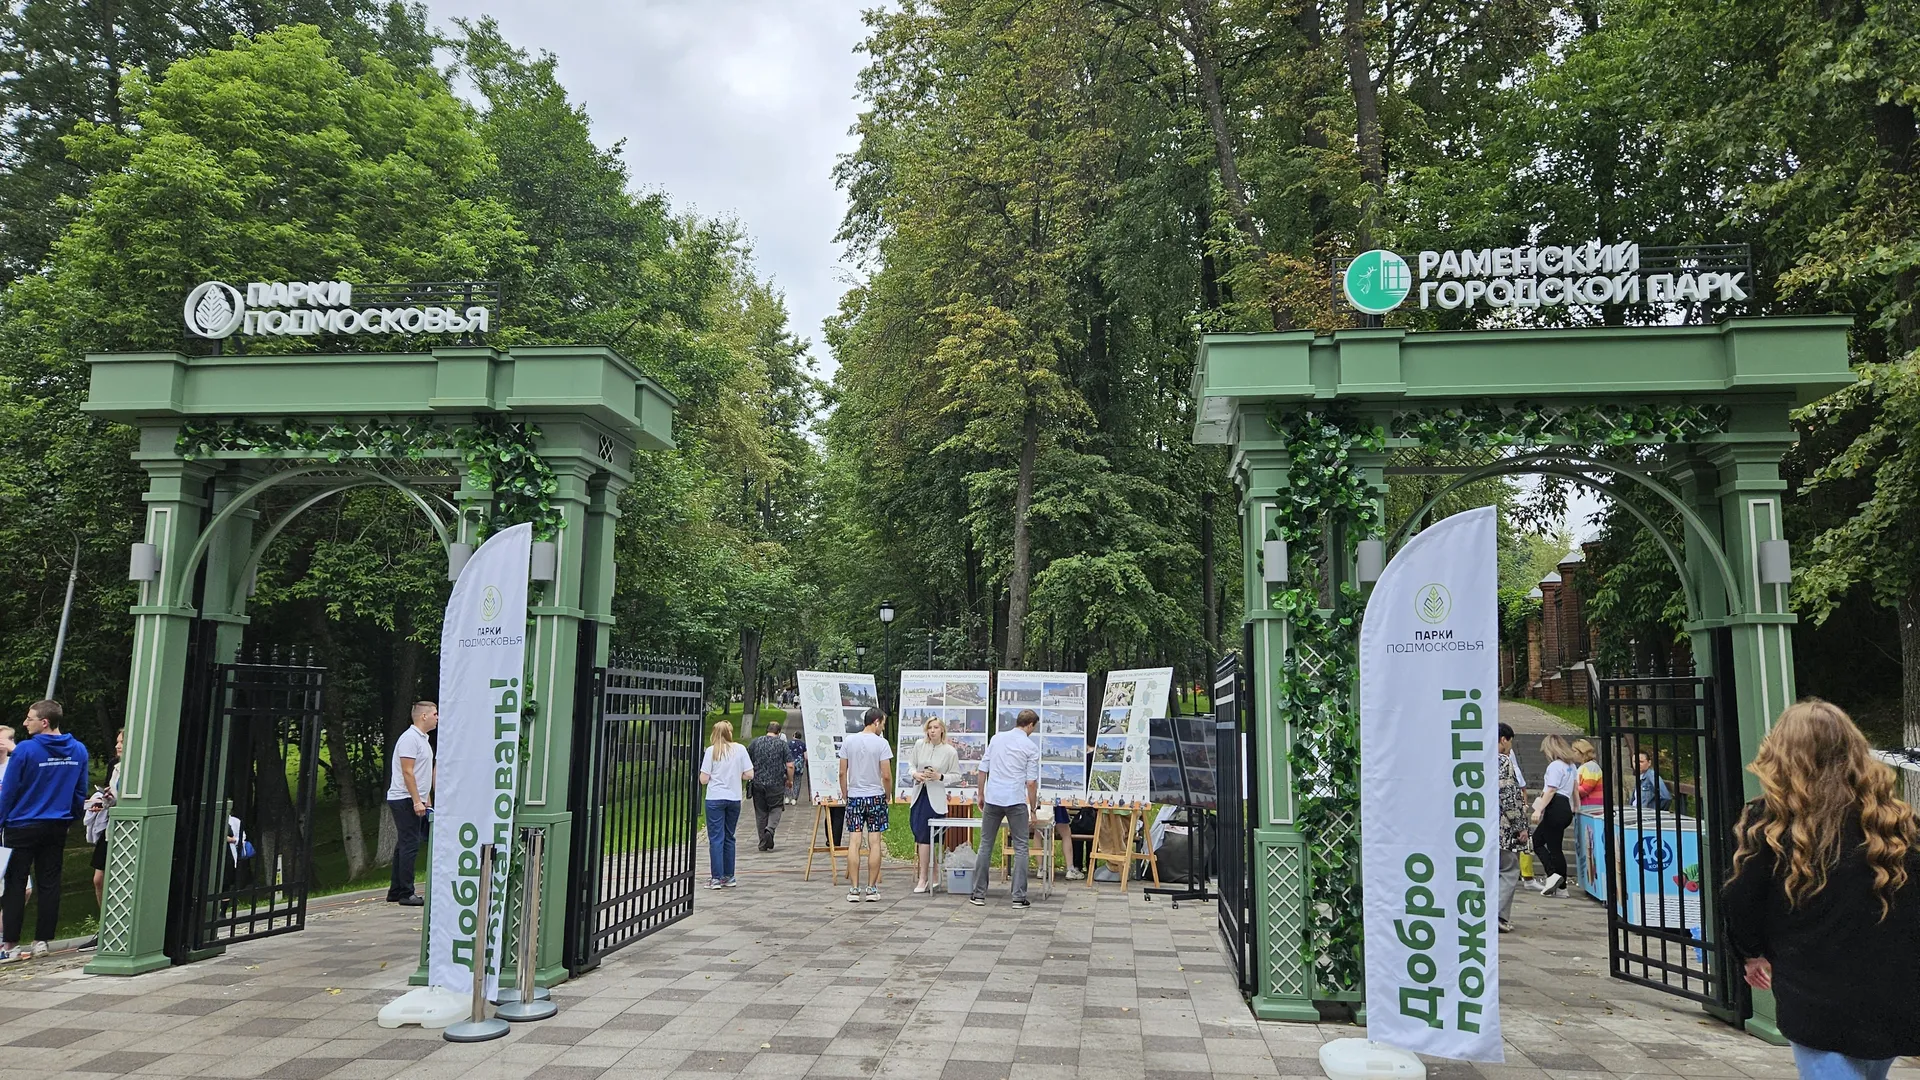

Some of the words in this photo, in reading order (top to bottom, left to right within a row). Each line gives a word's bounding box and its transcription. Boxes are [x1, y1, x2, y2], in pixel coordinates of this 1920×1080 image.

[1418, 240, 1640, 279] РАМЕНСКИЙ
[246, 281, 352, 307] ПАРКИ
[1419, 272, 1640, 310] ГОРОДСКОЙ
[1646, 271, 1749, 303] ПАРК
[243, 306, 489, 336] ПОДМОСКОВЬЯ
[458, 636, 523, 648] ПОДМОСКОВЬЯ
[1386, 641, 1485, 654] ПОДМОСКОВЬЯ
[1415, 630, 1453, 640] ПАРКИ
[1442, 688, 1487, 1034] пожаловать!
[452, 822, 479, 974] Добро
[1393, 852, 1446, 1030] Добро
